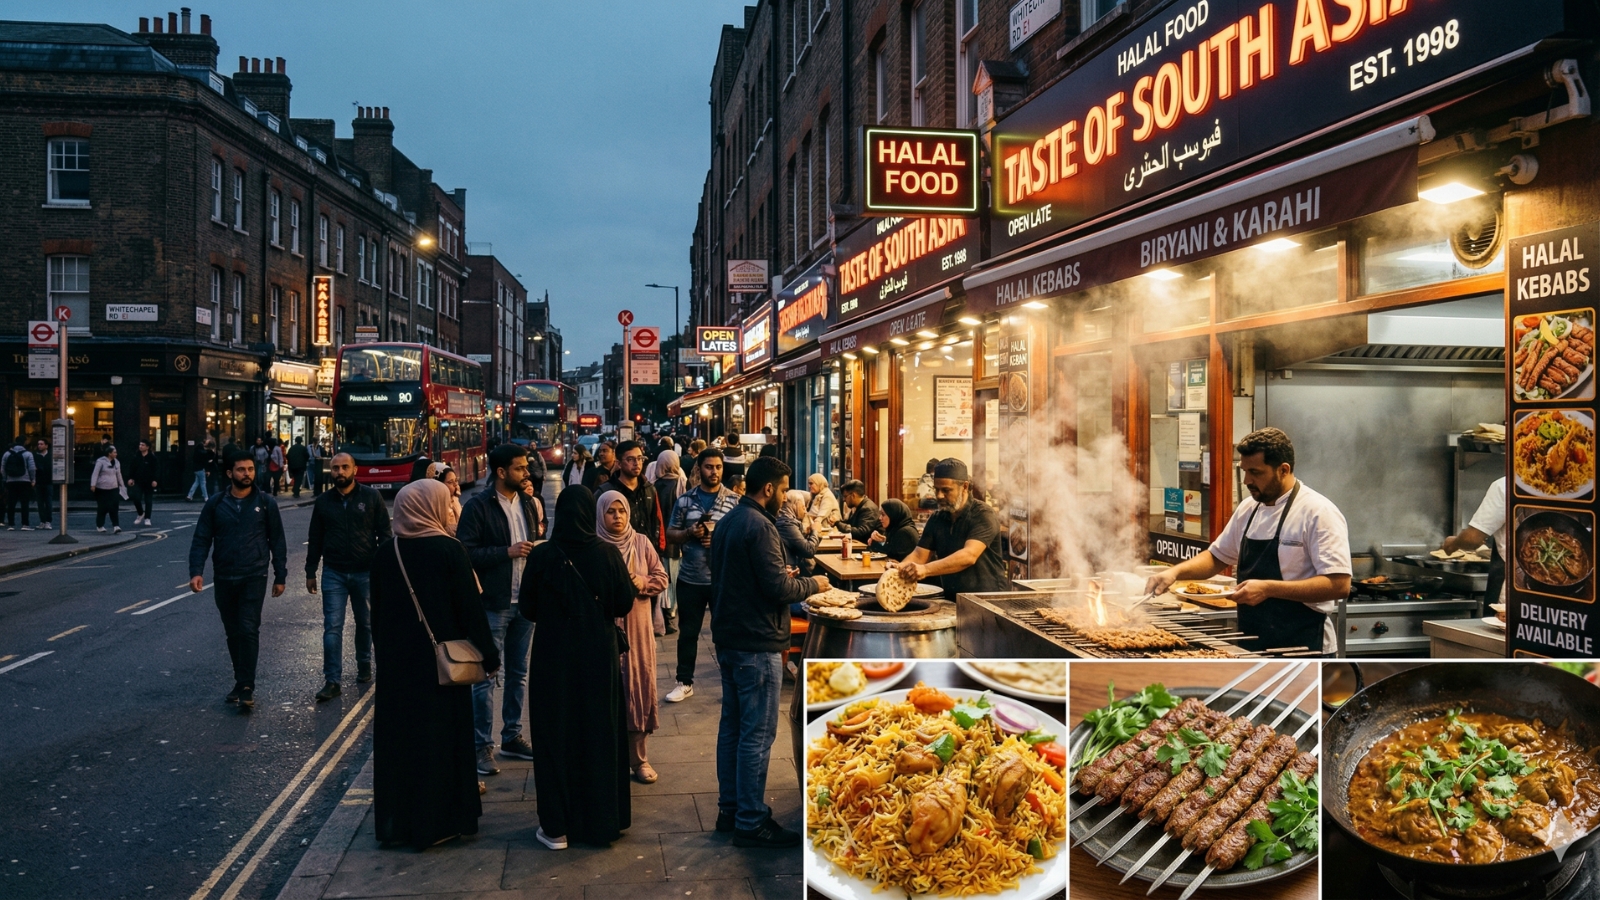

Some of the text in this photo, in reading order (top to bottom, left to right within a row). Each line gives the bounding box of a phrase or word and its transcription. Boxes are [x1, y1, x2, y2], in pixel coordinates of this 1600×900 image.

[1012, 0, 1045, 26] WHITEC
[1012, 26, 1021, 44] RD
[1118, 0, 1209, 76] HALAL FOOD
[1350, 19, 1460, 92] EST. 1998
[1004, 120, 1078, 205] TASTE
[1083, 91, 1125, 165] OF
[1132, 3, 1275, 142] SOUTH
[1289, 0, 1409, 65] AS
[878, 140, 966, 166] HALAL
[885, 170, 959, 195] FOOD
[1008, 203, 1052, 237] OPEN LATE
[1140, 186, 1321, 268] BIRYANI & KARAHI
[839, 251, 869, 295] TASTE
[868, 242, 883, 281] OF
[884, 218, 928, 274] SOUTH
[1522, 237, 1584, 270] HALAL
[996, 261, 1081, 306] HALAL KEBABS
[1517, 267, 1591, 301] KEBABS
[59, 308, 68, 320] K
[109, 306, 156, 314] WHITECHAPEL
[621, 312, 631, 324] K
[701, 341, 737, 351] LATES
[703, 330, 735, 341] OPEN
[1156, 539, 1179, 559] OPEN
[1520, 602, 1588, 631] DELIVERY
[1516, 623, 1593, 655] AVAILABLE
